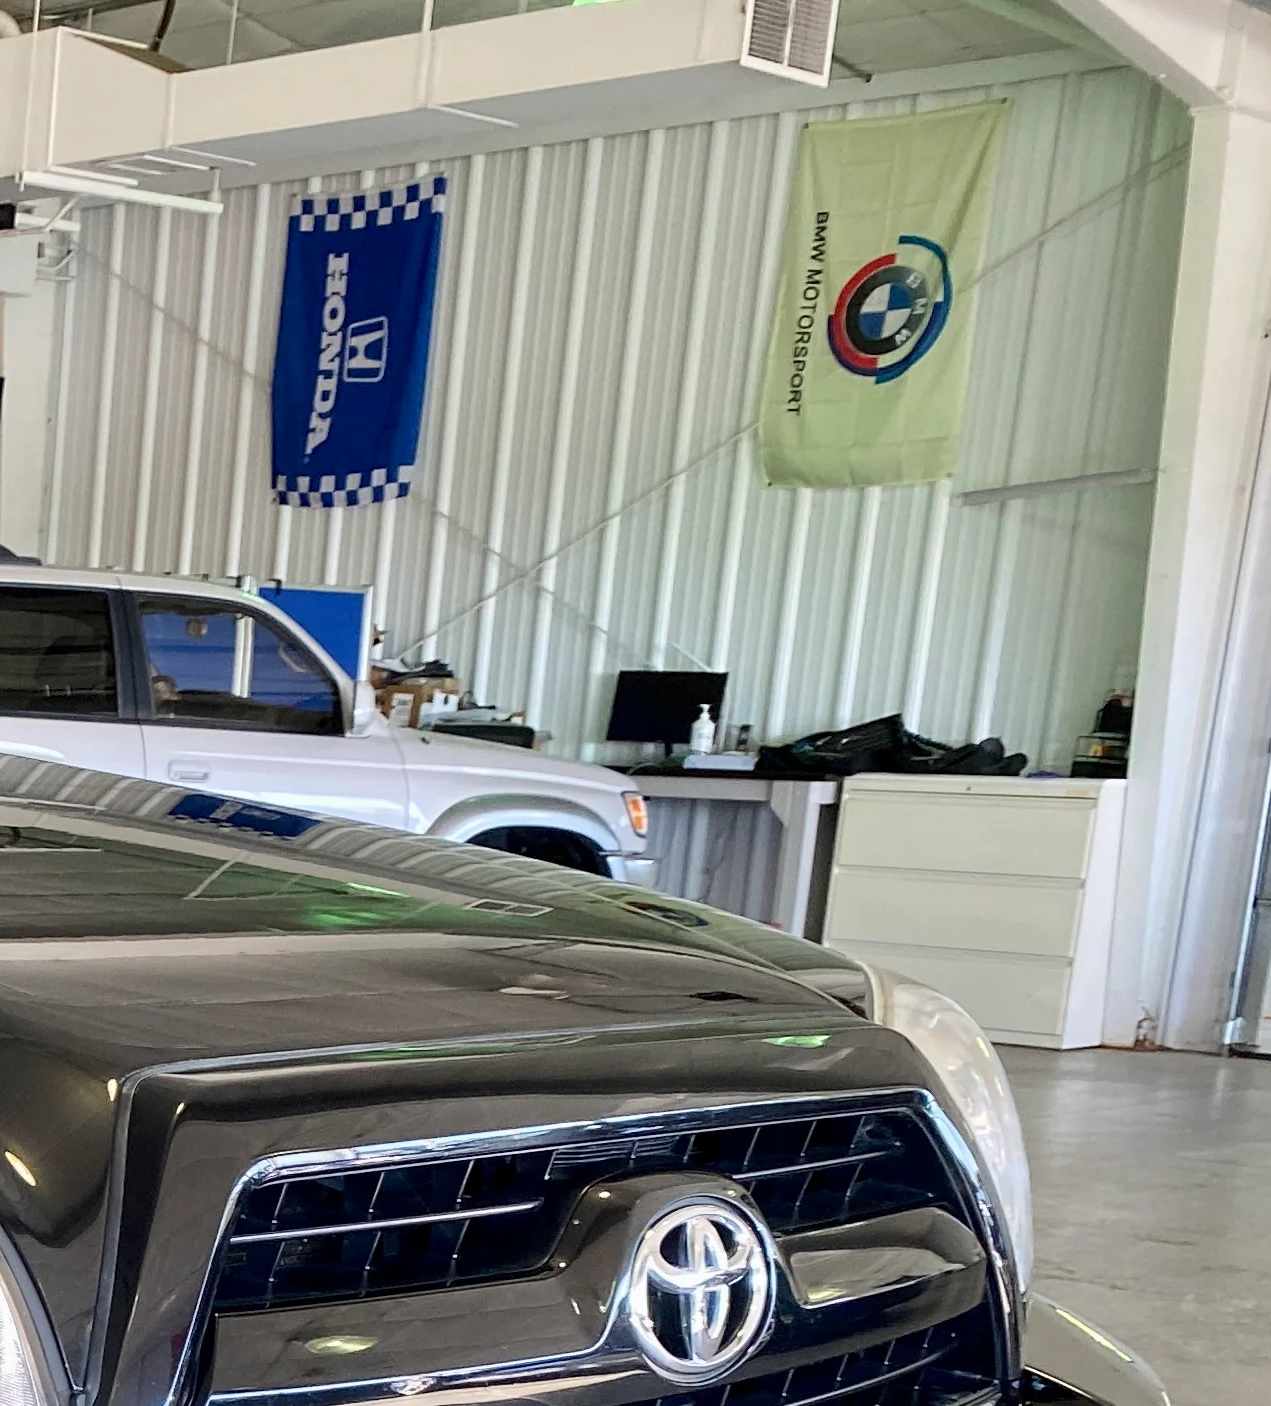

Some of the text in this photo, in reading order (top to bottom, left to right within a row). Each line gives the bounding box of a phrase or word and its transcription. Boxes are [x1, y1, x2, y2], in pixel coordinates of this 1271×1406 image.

[305, 252, 350, 455] HONDA
[787, 211, 831, 417] BMW MOTORSPORT
